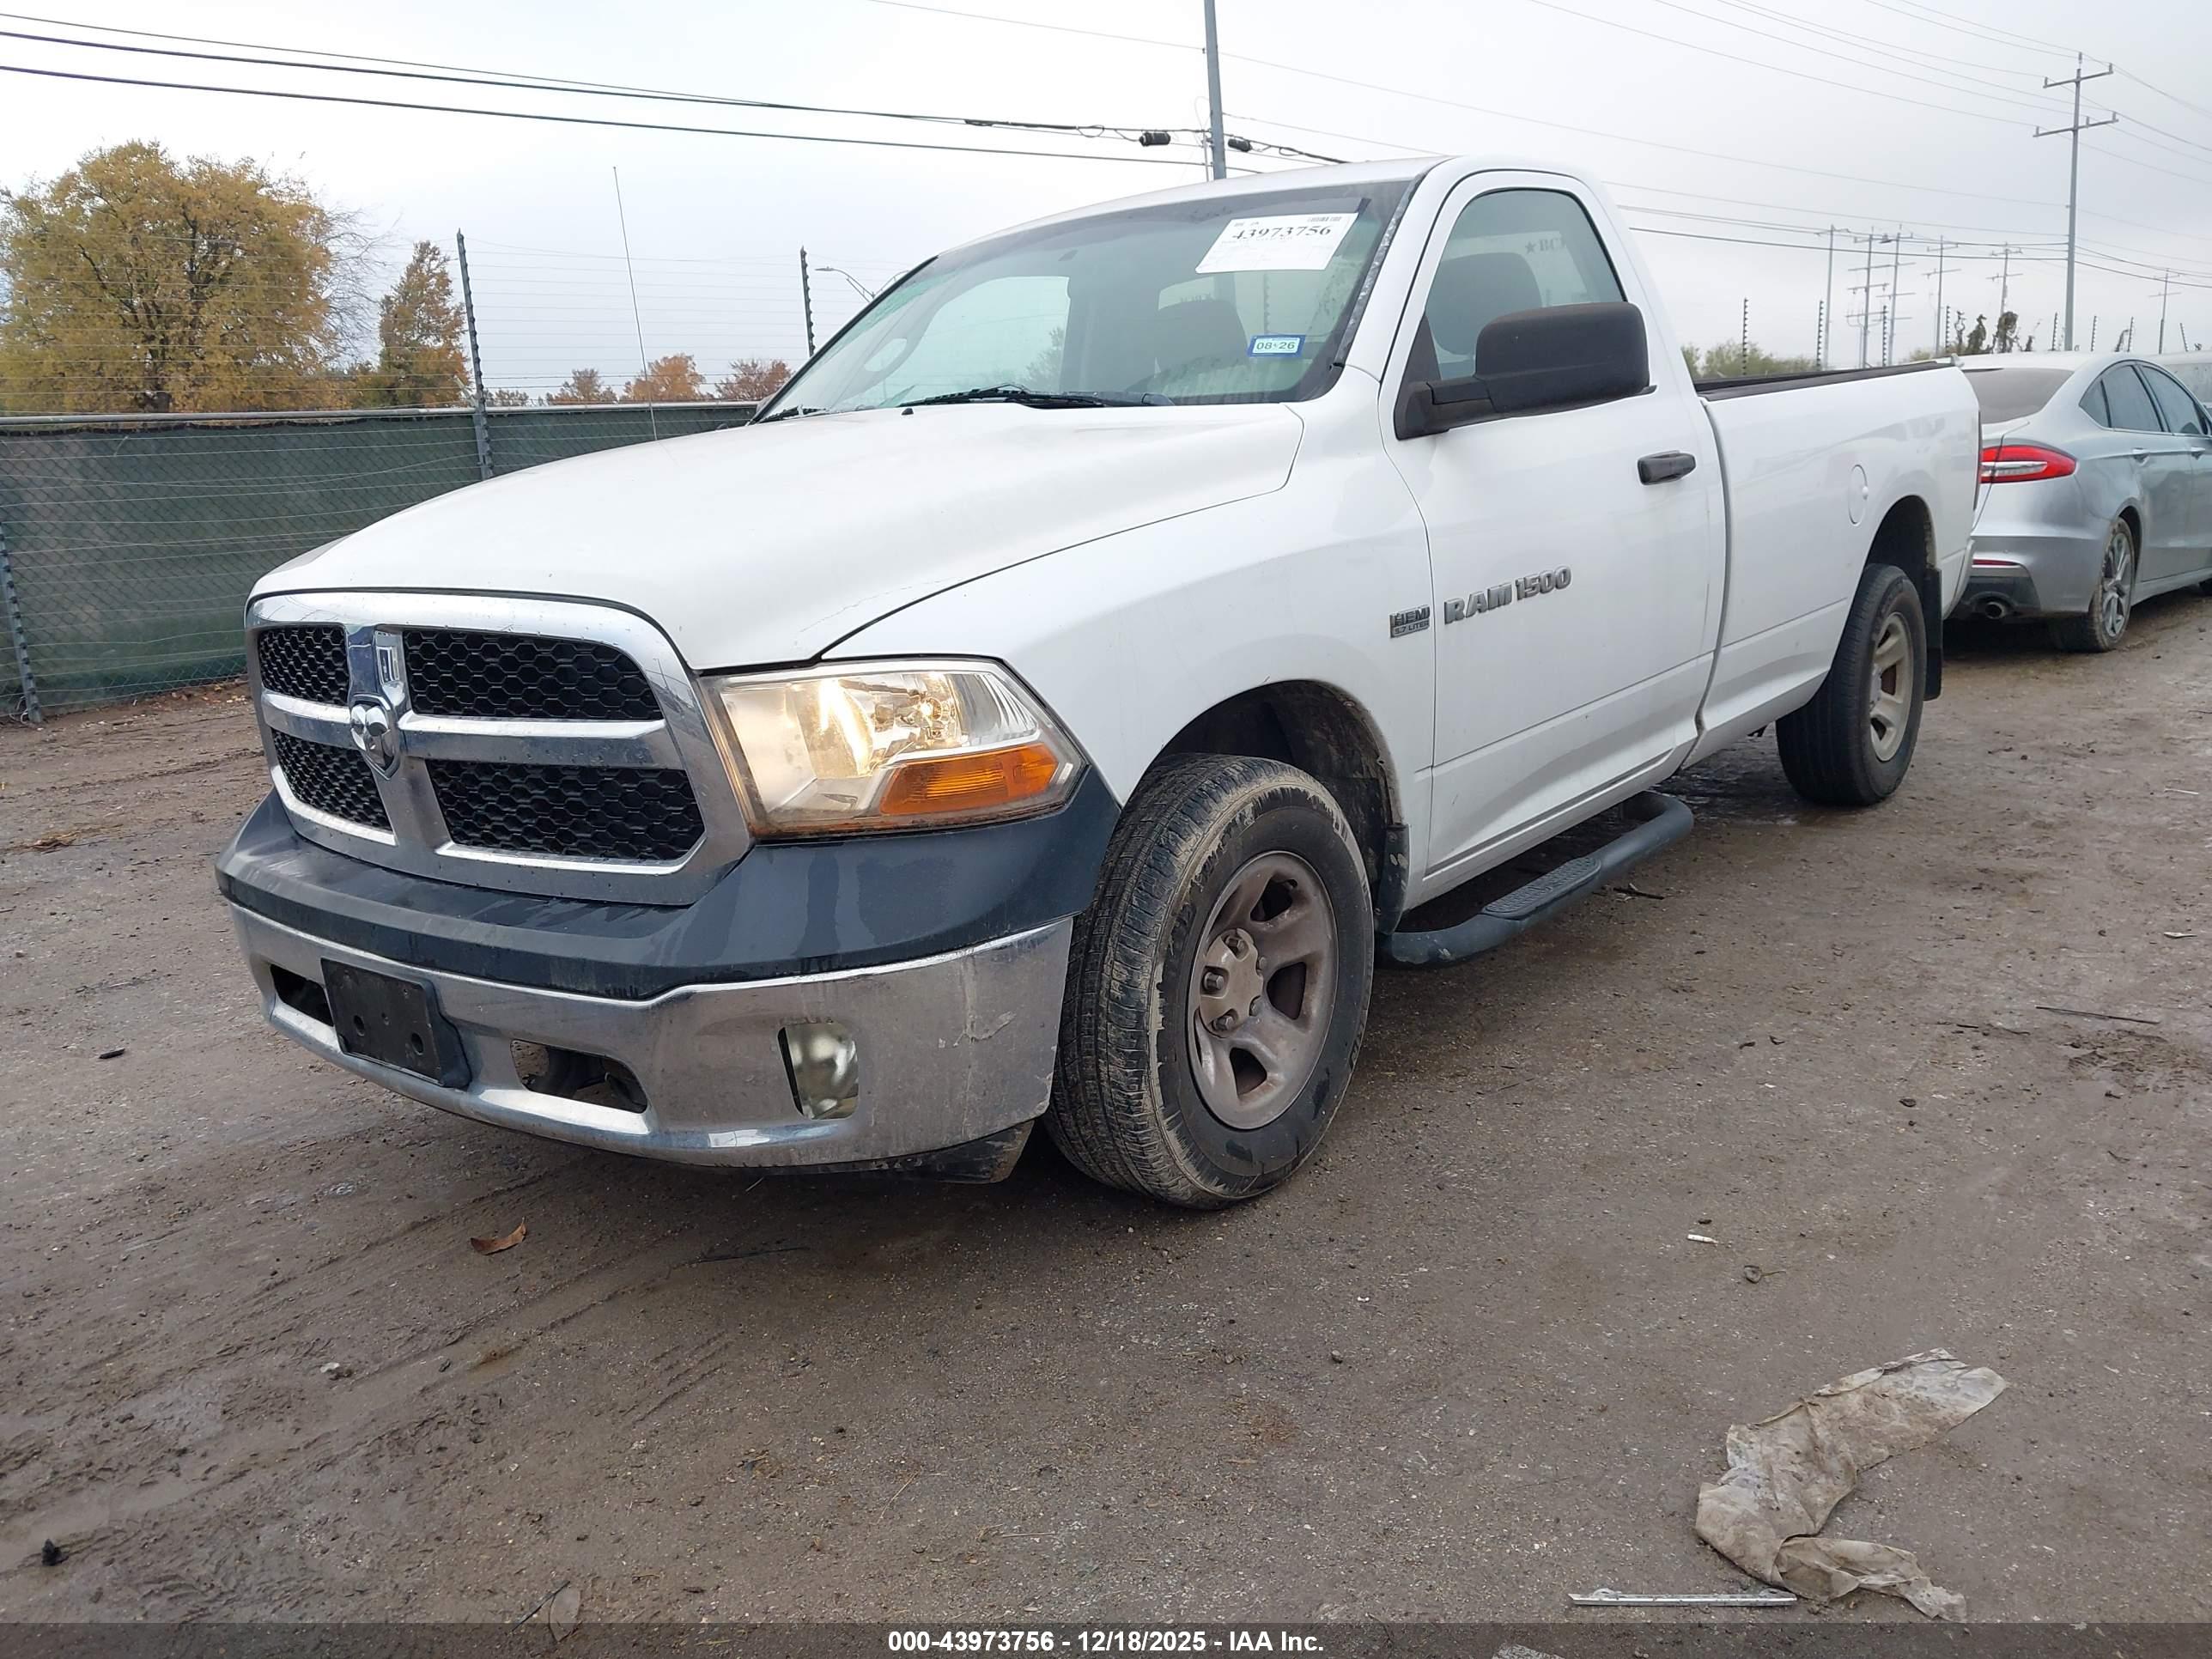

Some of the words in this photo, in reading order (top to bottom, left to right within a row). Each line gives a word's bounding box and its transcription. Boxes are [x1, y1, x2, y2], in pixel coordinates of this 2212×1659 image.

[1232, 225, 1333, 240] 43973756
[1444, 582, 1512, 625] RAM
[1515, 564, 1573, 601] 1500
[1389, 605, 1431, 627] HEMI
[1395, 626, 1407, 635] 5.7
[1408, 619, 1430, 631] LITER
